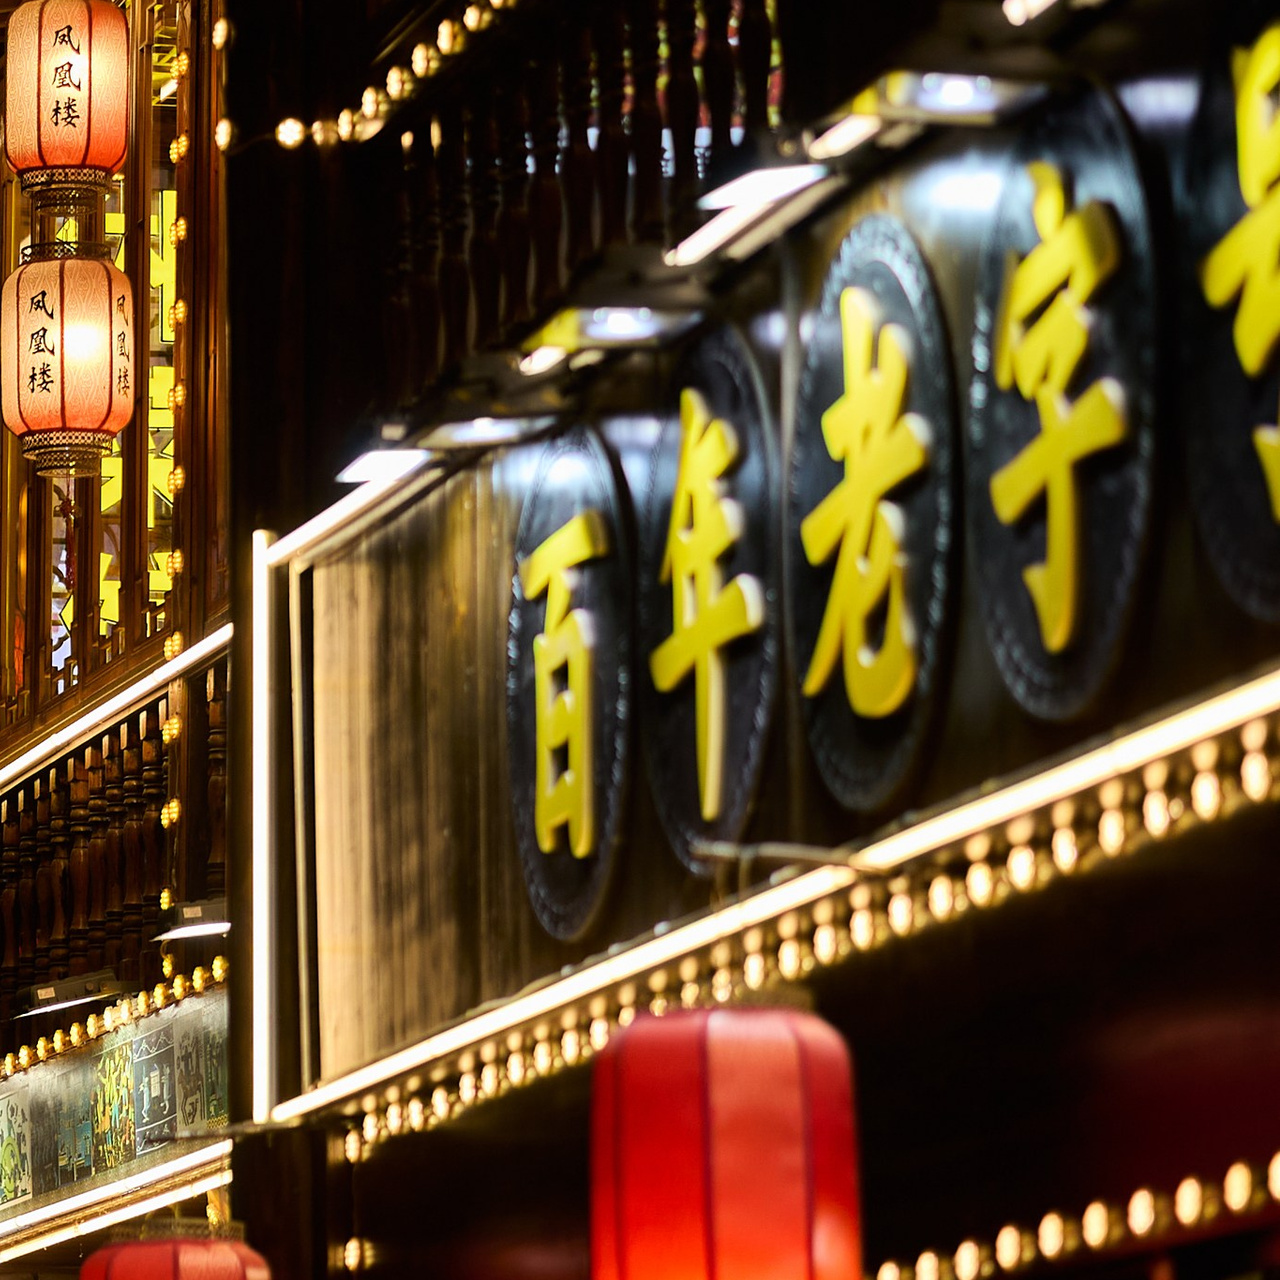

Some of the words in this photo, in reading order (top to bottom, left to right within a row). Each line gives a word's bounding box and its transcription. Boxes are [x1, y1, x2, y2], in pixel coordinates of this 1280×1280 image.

[50, 24, 81, 128] 凤凰楼
[27, 290, 55, 394] 凤凰楼
[116, 294, 130, 399] 凤凰楼
